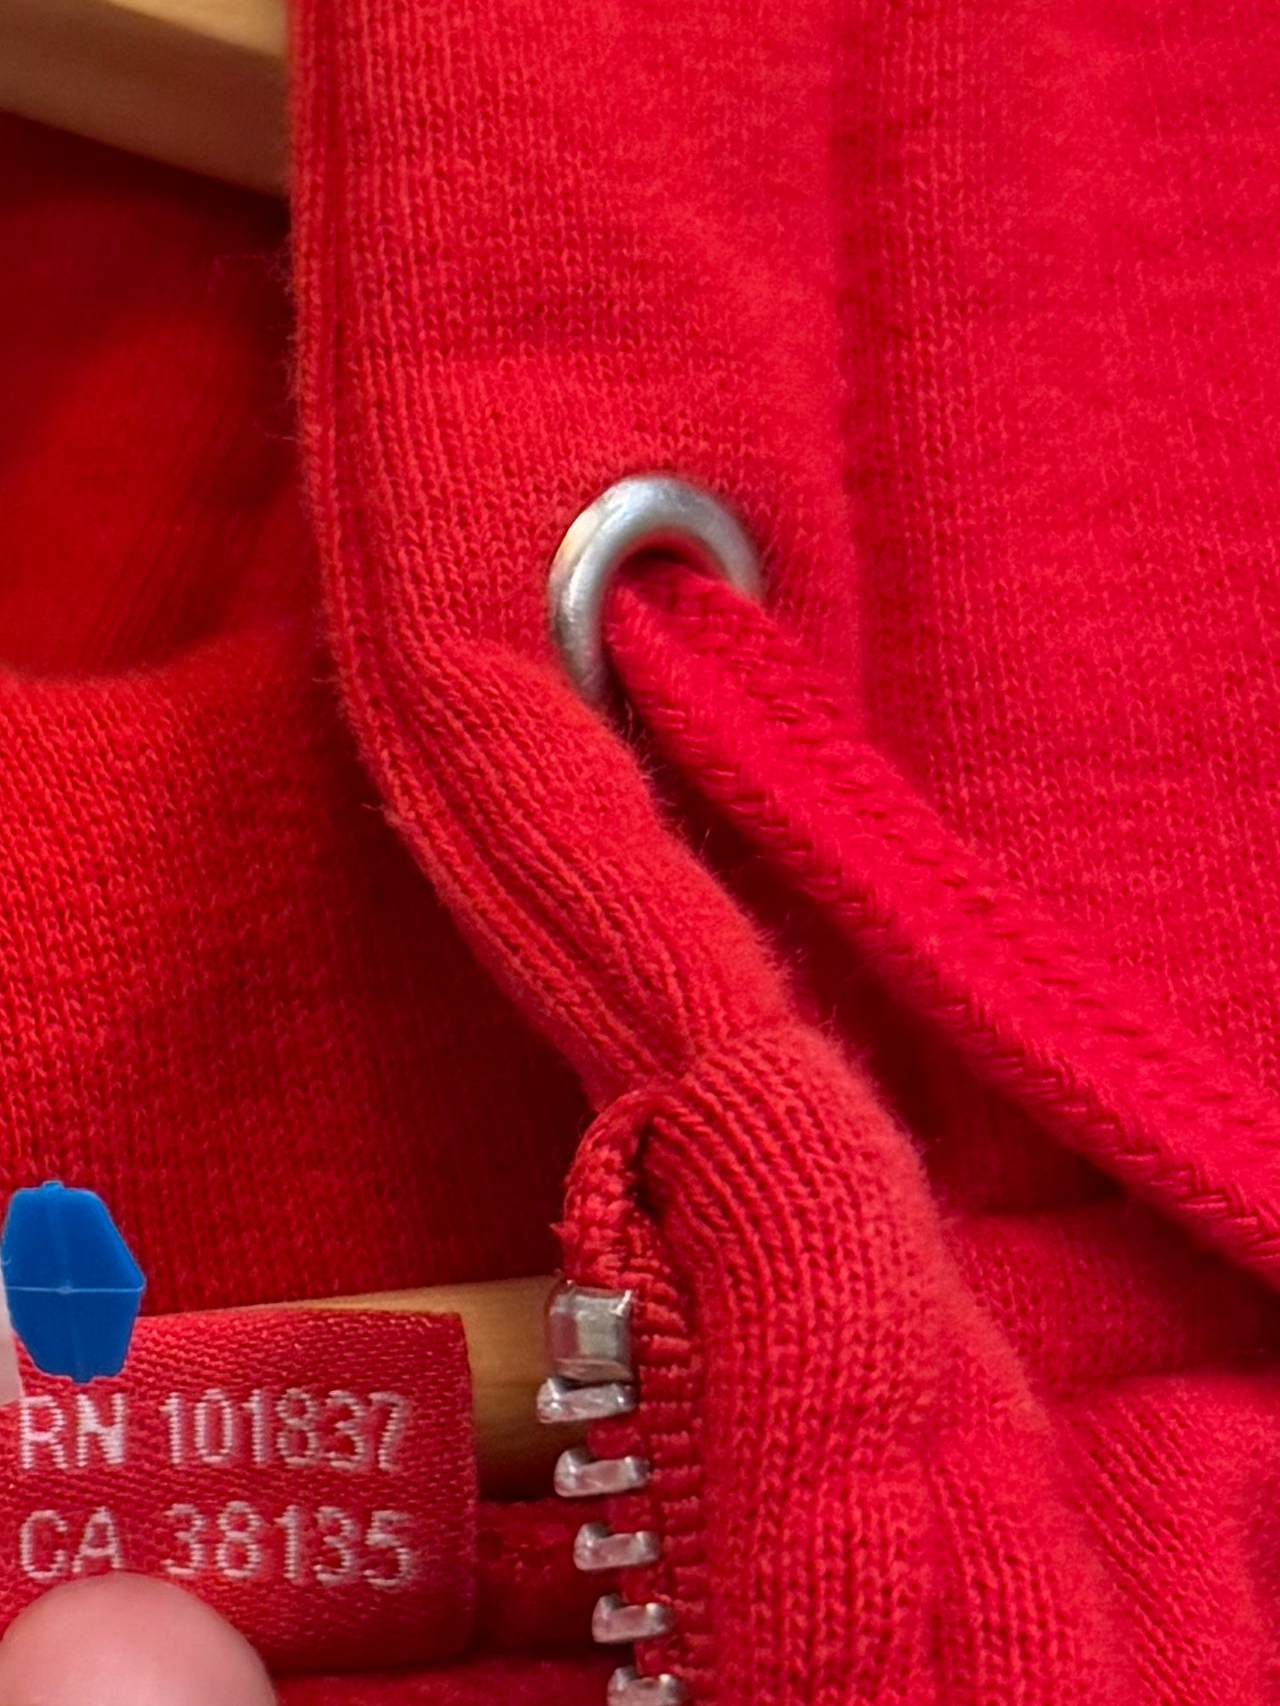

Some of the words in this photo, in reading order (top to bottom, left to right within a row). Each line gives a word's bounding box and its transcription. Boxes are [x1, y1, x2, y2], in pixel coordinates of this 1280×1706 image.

[18, 1392, 127, 1470] RN
[159, 1388, 411, 1472] 101837
[19, 1505, 124, 1580] CA
[161, 1500, 415, 1590] 38135
